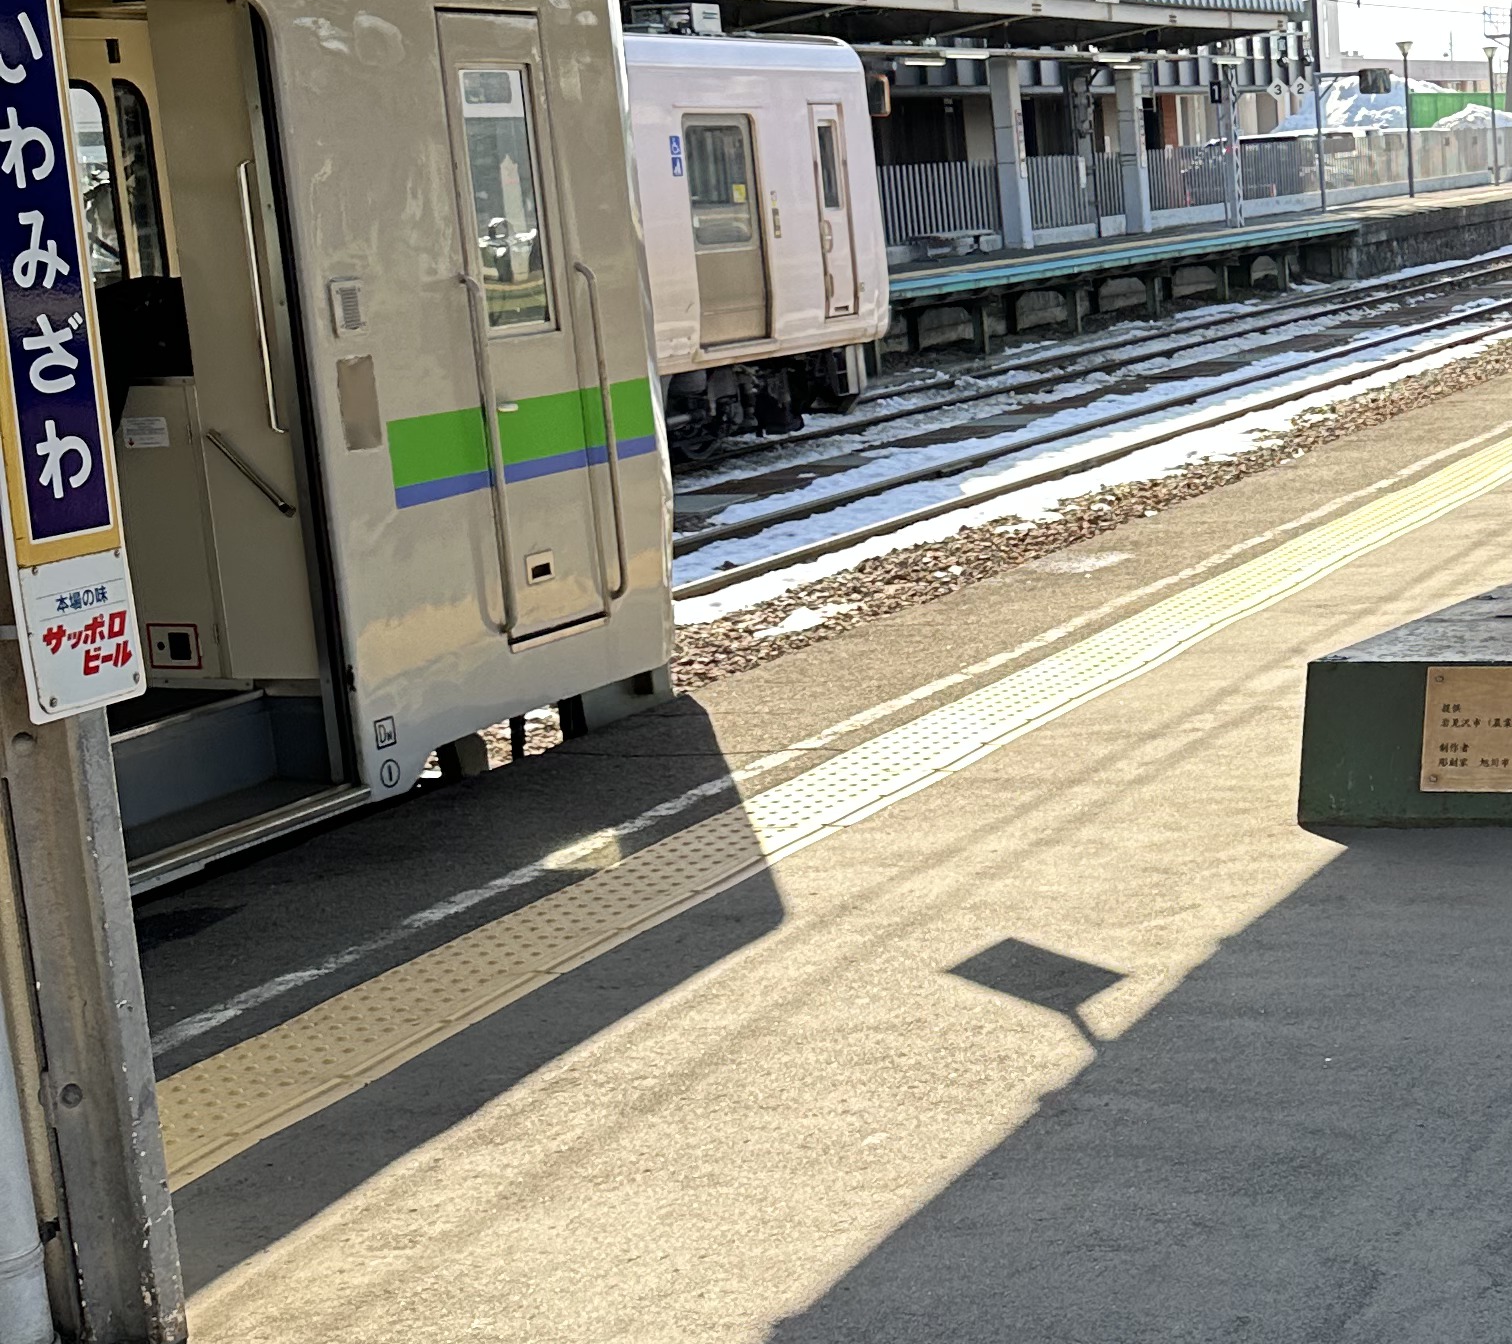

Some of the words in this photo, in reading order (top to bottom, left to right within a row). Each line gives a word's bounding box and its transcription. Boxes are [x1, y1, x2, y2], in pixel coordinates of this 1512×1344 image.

[1212, 85, 1219, 101] 1
[1274, 84, 1282, 95] 3
[1297, 83, 1305, 94] 2
[0, 11, 94, 500] いわみざわ
[55, 585, 109, 613] 本場の味
[42, 609, 128, 655] サッポロ
[82, 639, 133, 676] ビール
